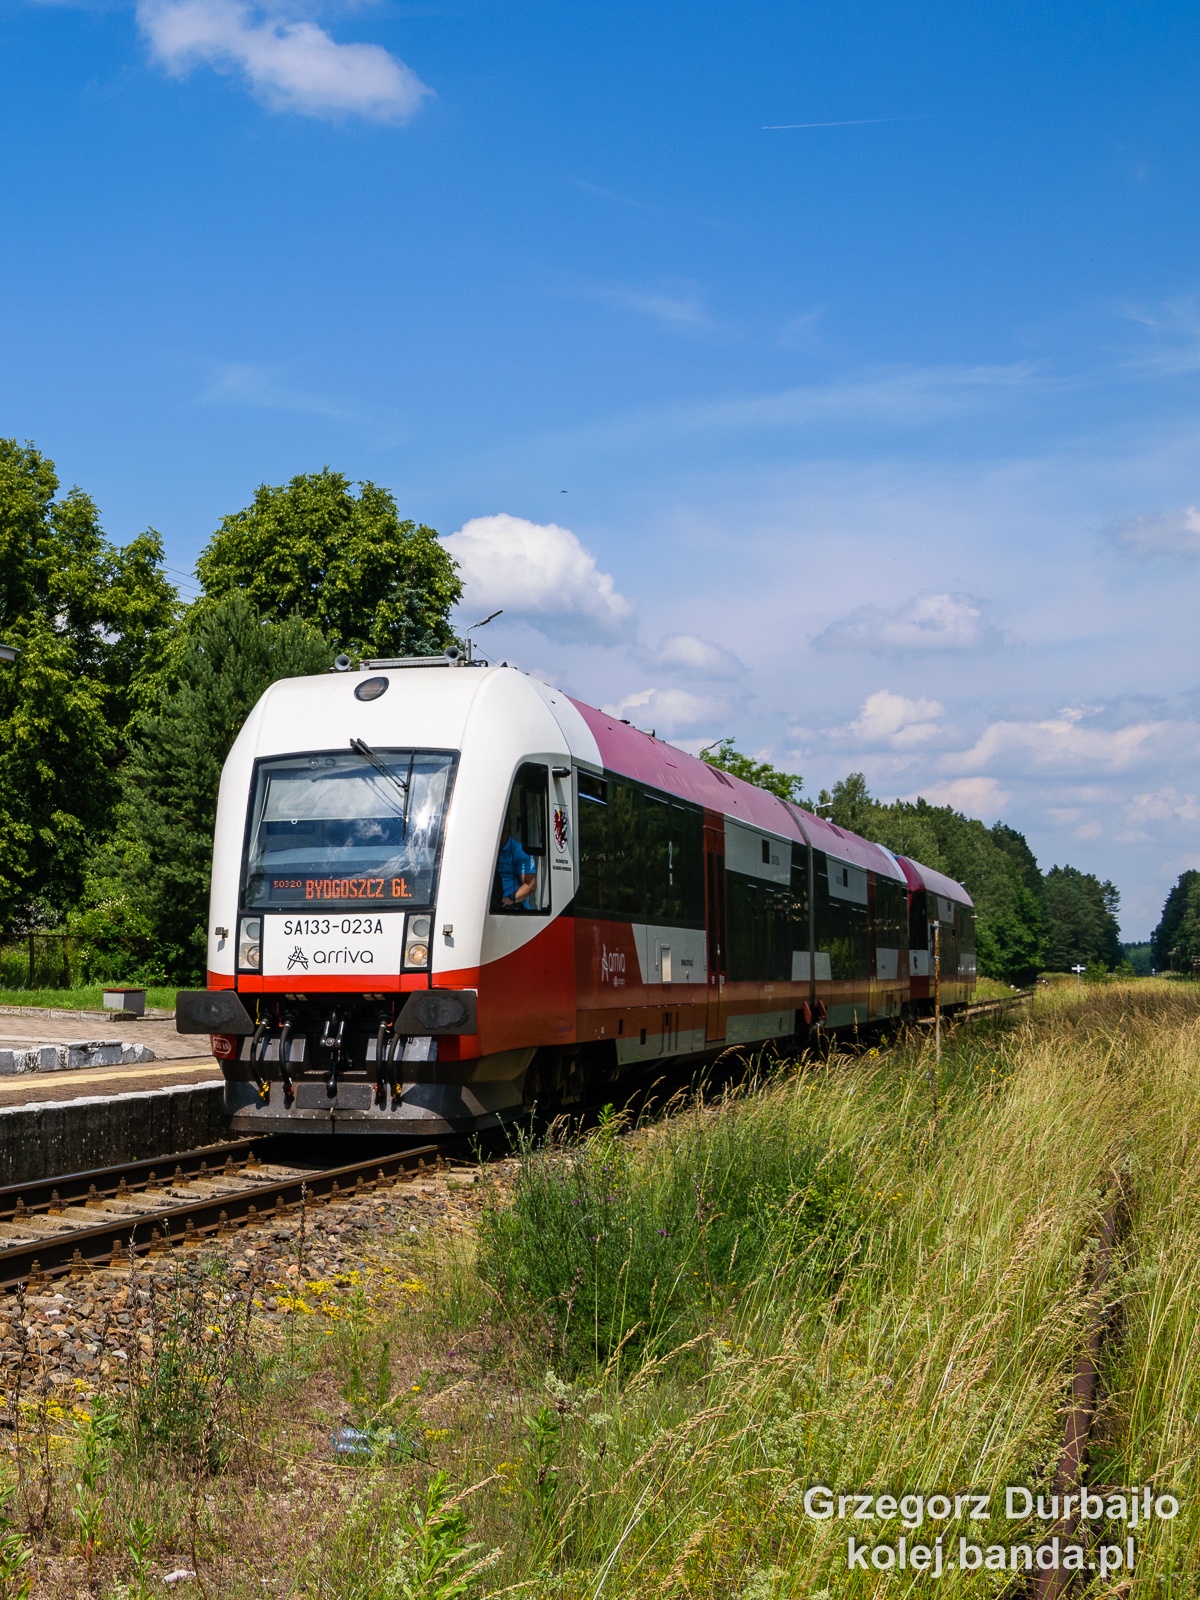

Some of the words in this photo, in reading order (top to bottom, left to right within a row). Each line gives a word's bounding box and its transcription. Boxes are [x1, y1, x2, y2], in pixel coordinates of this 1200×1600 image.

[273, 880, 303, 889] 50320
[305, 878, 385, 899] BYDGOSZCZ
[391, 878, 413, 898] GŁ.
[283, 918, 383, 936] SA133-023A
[313, 946, 374, 964] arriva
[608, 946, 626, 973] arriva
